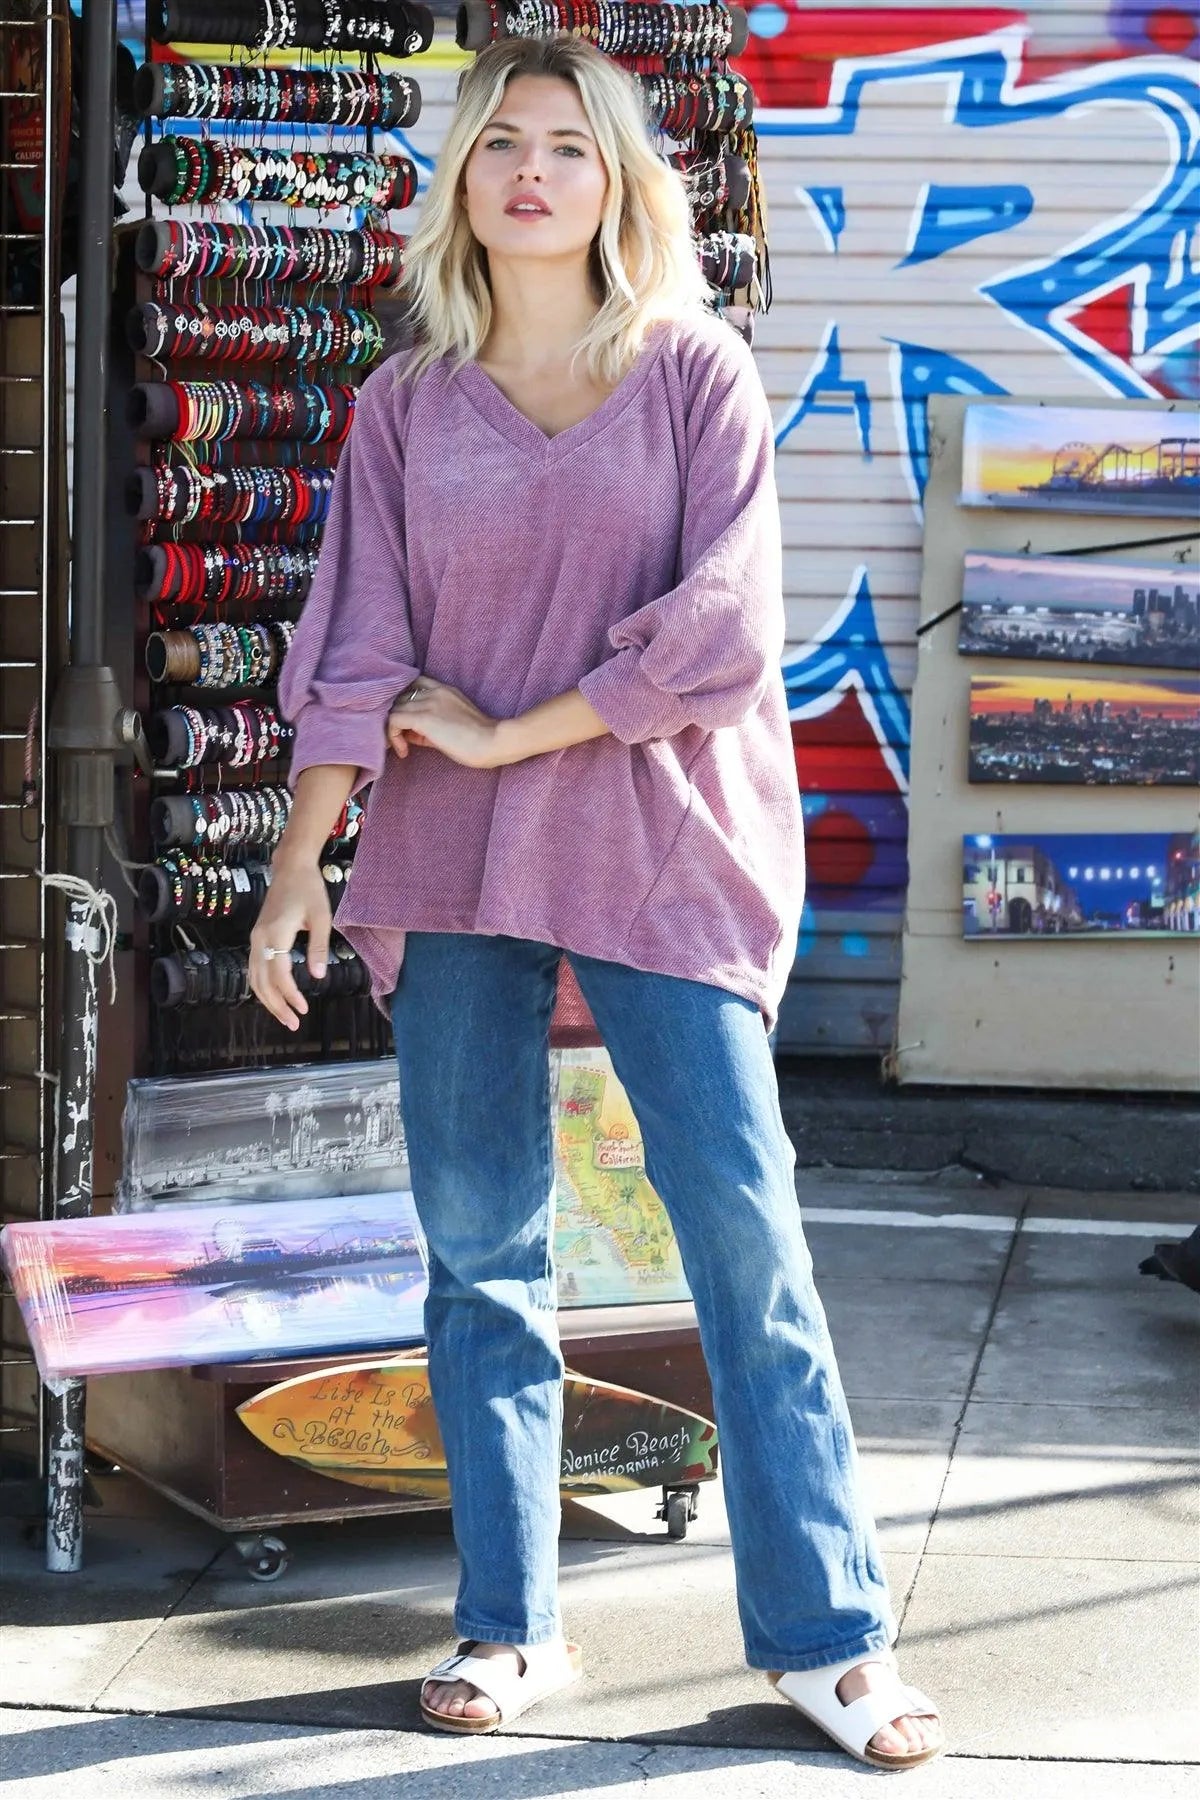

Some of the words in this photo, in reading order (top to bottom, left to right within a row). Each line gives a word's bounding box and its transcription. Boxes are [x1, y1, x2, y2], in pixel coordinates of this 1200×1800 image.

[15, 151, 45, 161] CALIFO
[310, 1379, 363, 1404] Life
[402, 1383, 431, 1408] Be
[328, 1404, 354, 1425] At
[373, 1409, 405, 1430] the
[562, 1445, 620, 1472] Venice
[626, 1427, 690, 1457] Beach
